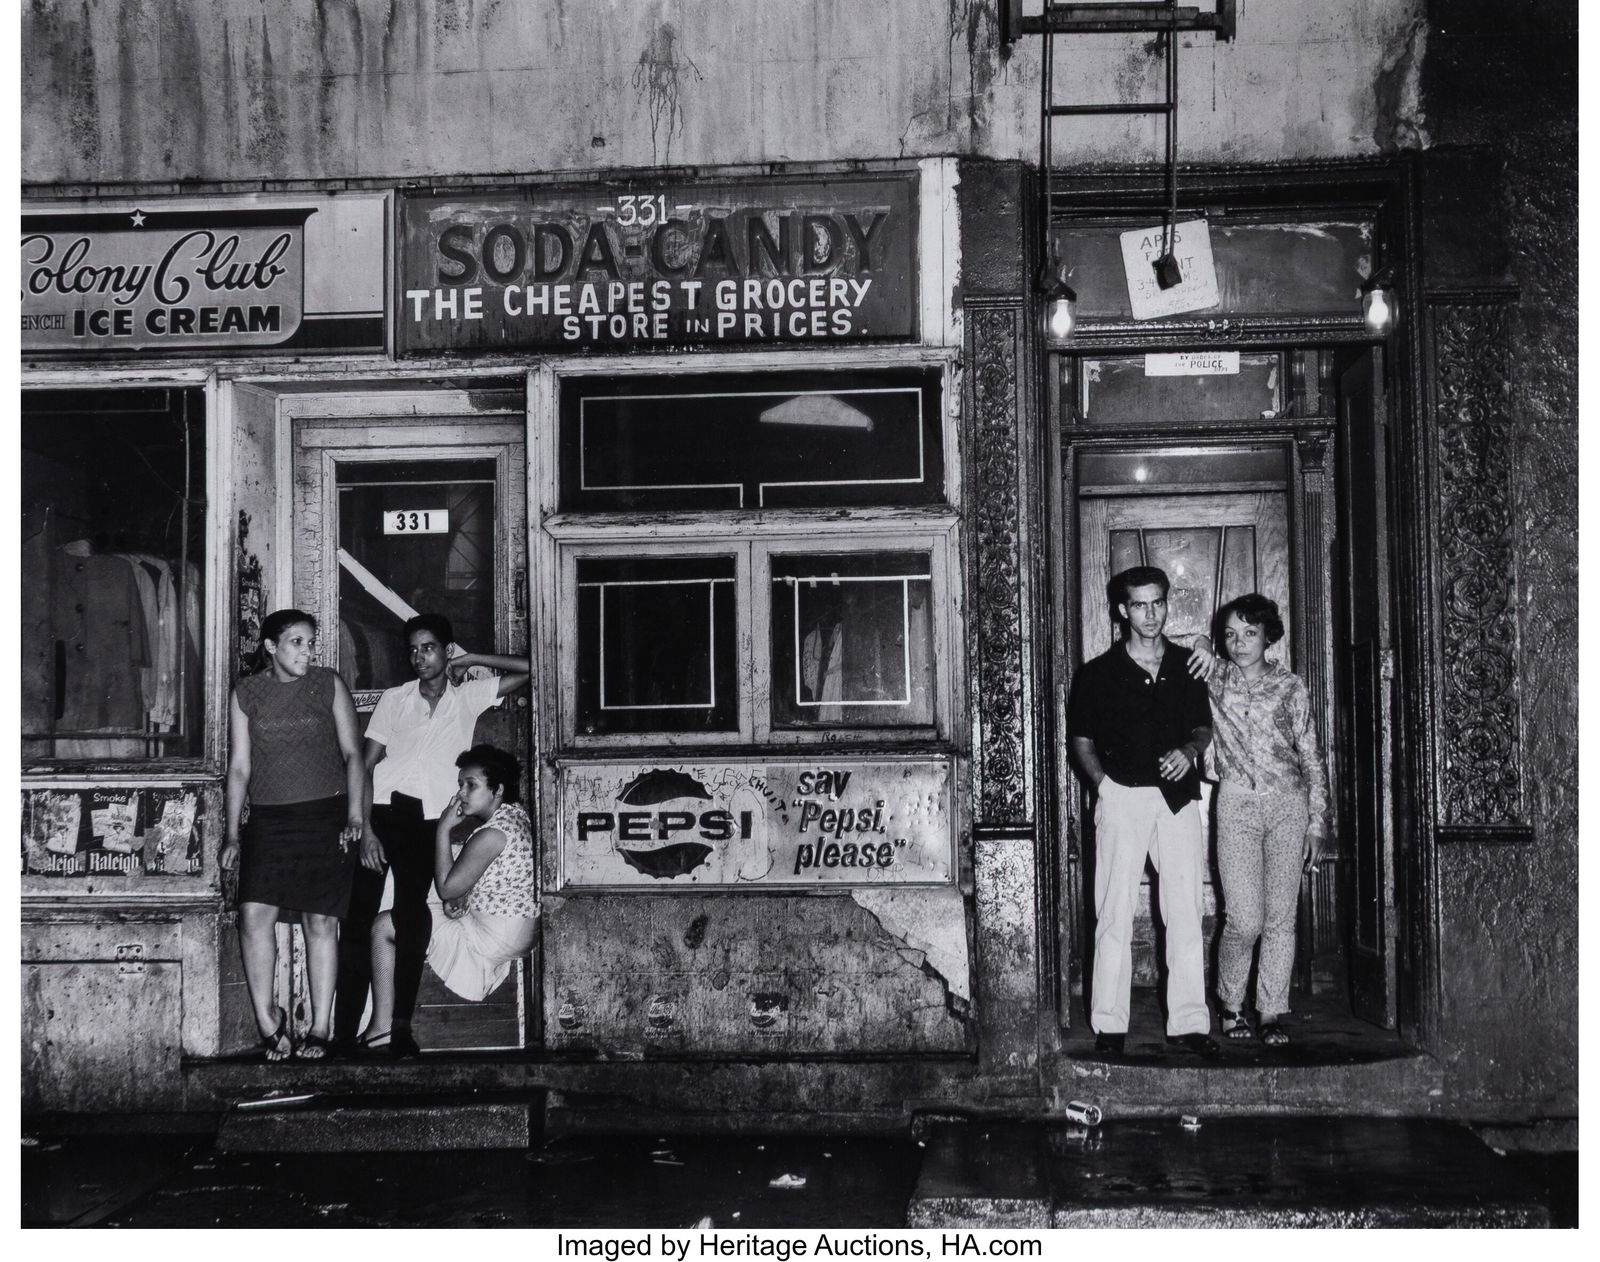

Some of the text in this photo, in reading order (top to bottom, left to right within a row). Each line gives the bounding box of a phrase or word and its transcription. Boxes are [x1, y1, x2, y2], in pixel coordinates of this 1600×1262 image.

[153, 230, 292, 305] Club
[406, 277, 873, 322] THE CHEAPEST GROCERY
[73, 308, 133, 337] ICE
[144, 305, 282, 335] CREAM
[563, 311, 669, 341] STORE
[686, 319, 709, 334] IN
[1190, 360, 1223, 369] POLICE
[396, 512, 430, 531] 331
[93, 792, 127, 803] Smoke
[797, 769, 852, 800] say
[576, 810, 753, 842] PEPSI
[89, 852, 139, 874] Raleigh
